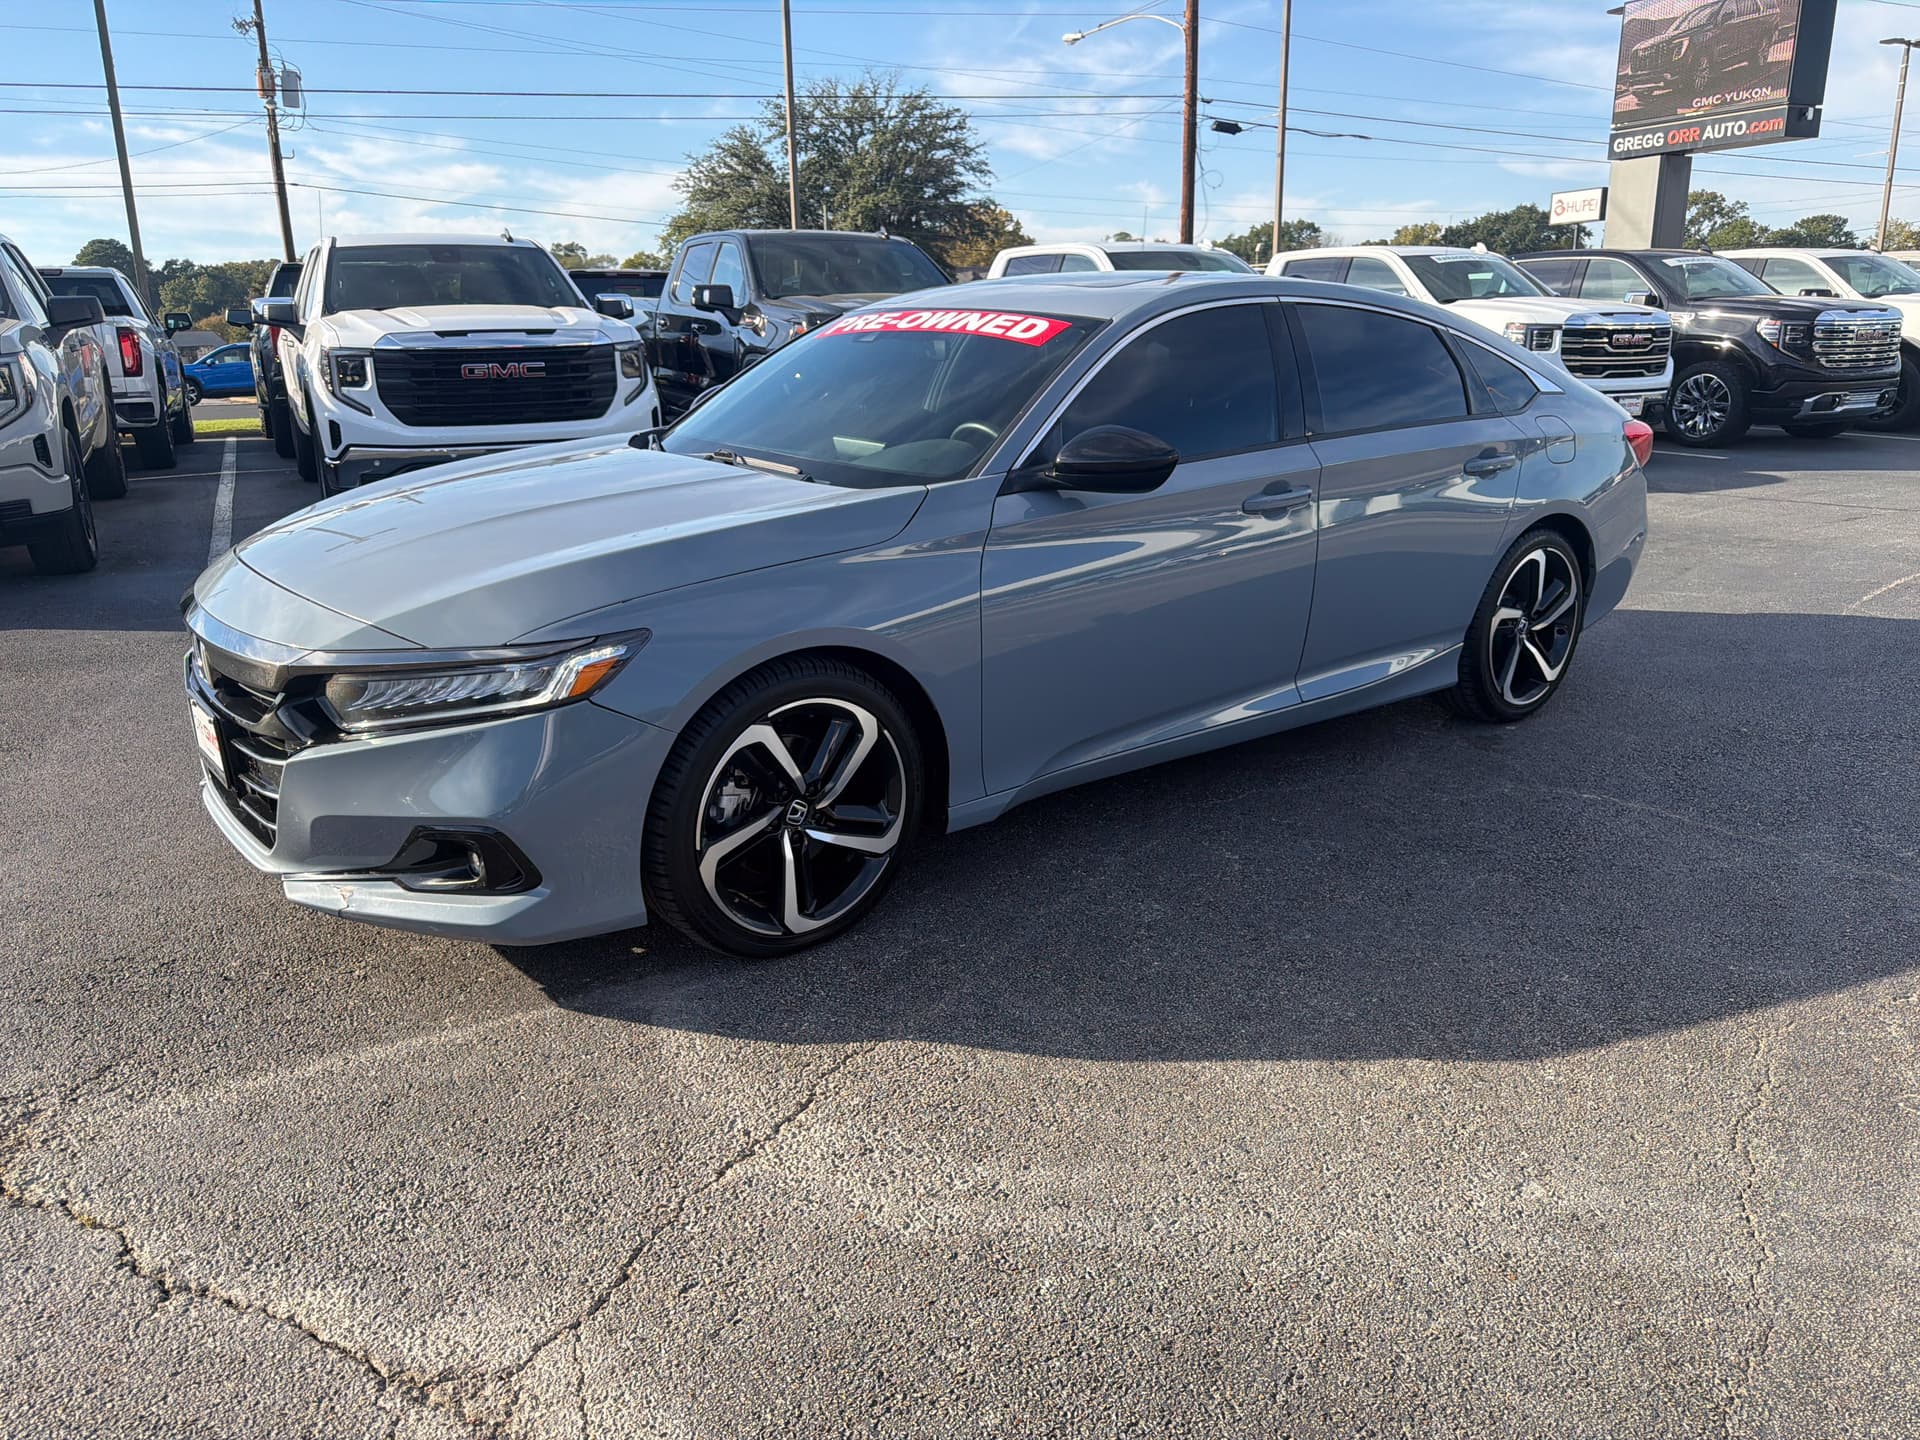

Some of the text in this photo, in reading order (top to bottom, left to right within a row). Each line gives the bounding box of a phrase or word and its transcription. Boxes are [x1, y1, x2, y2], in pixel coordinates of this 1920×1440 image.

[1692, 87, 1772, 109] GMC YUKON
[1613, 131, 1665, 153] GREGG
[1667, 126, 1700, 146] ORR
[825, 311, 1050, 339] PRE-OWNED
[1612, 333, 1653, 346] GMC
[461, 362, 546, 379] GMC
